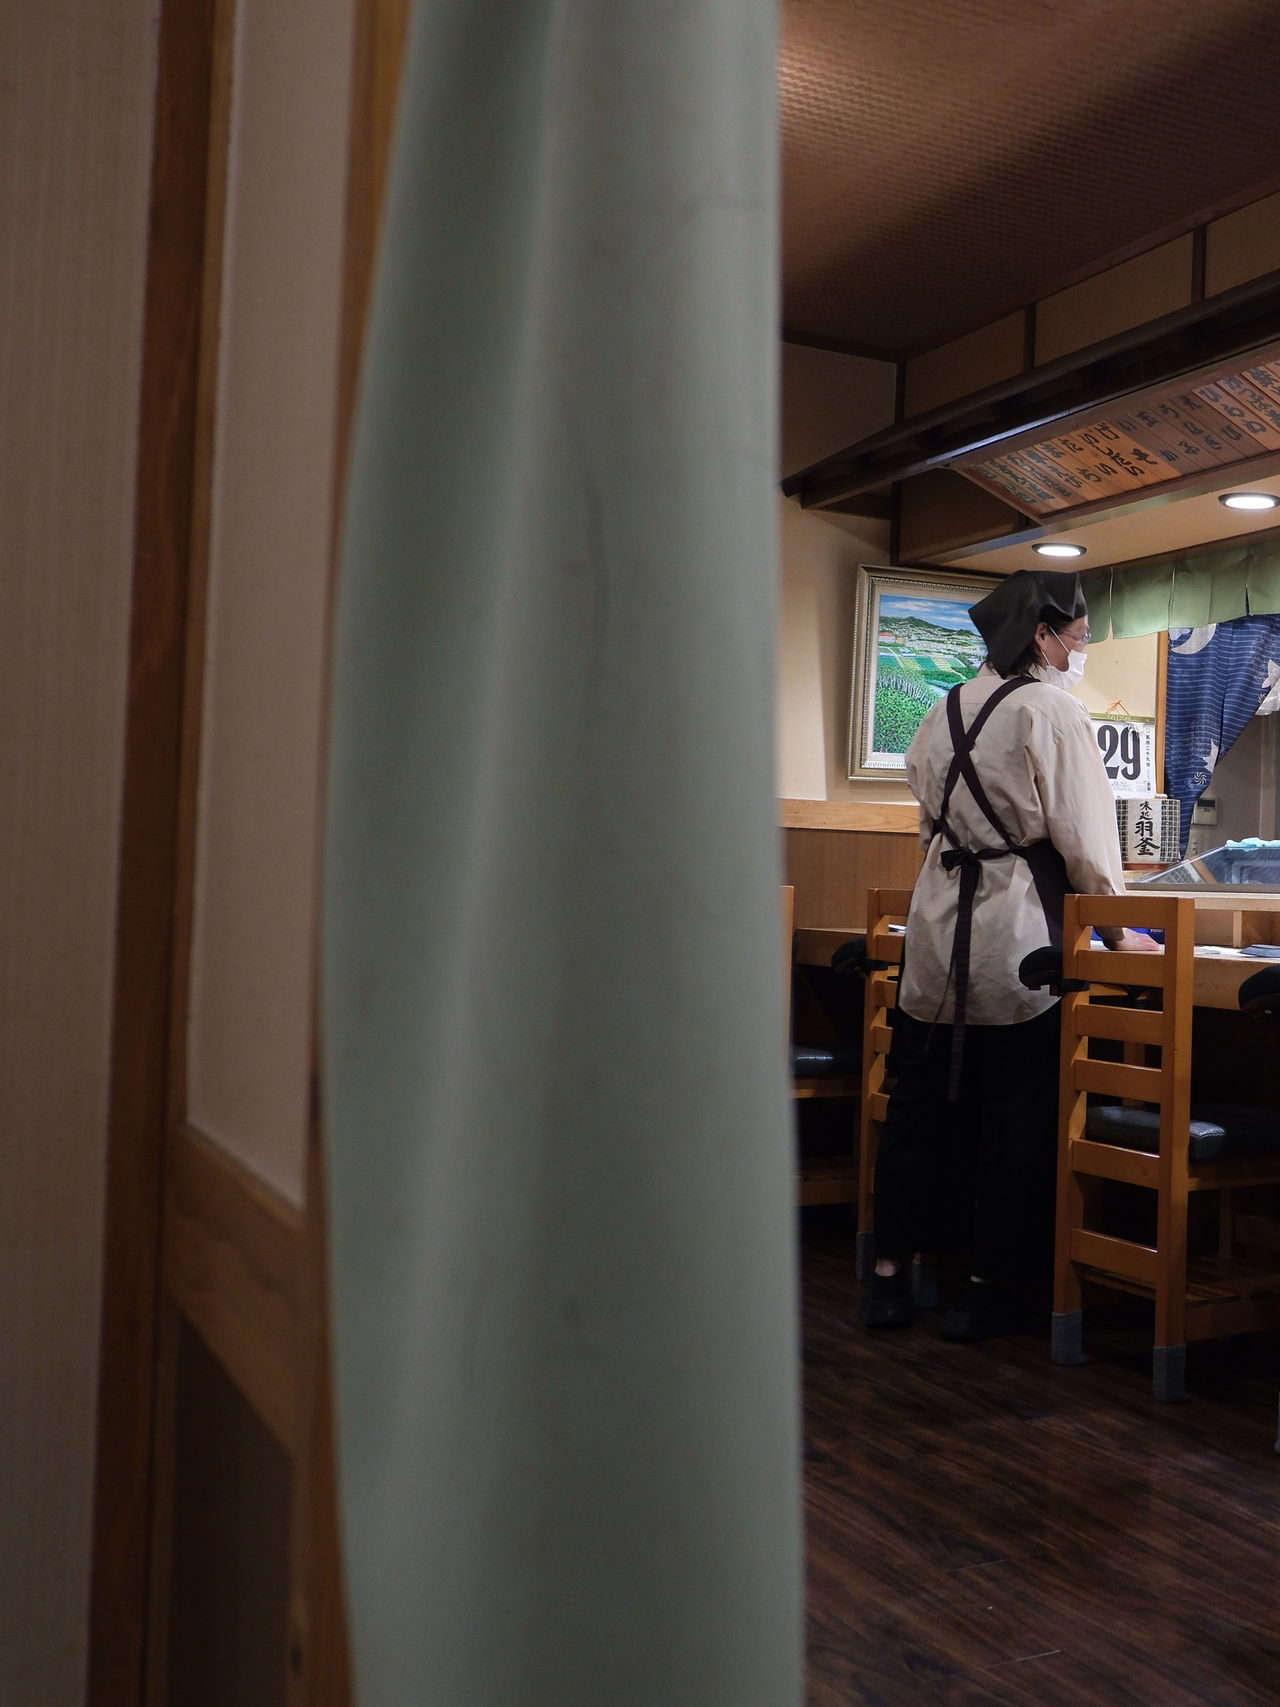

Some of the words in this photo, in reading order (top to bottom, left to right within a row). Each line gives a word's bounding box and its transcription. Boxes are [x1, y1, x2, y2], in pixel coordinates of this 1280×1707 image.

[1094, 422, 1158, 465] げそ
[1116, 419, 1179, 462] いか
[1159, 403, 1222, 450] うなぎ
[1058, 438, 1118, 476] たい
[1097, 725, 1141, 780] 29
[1133, 800, 1161, 856] 味処羽釜
